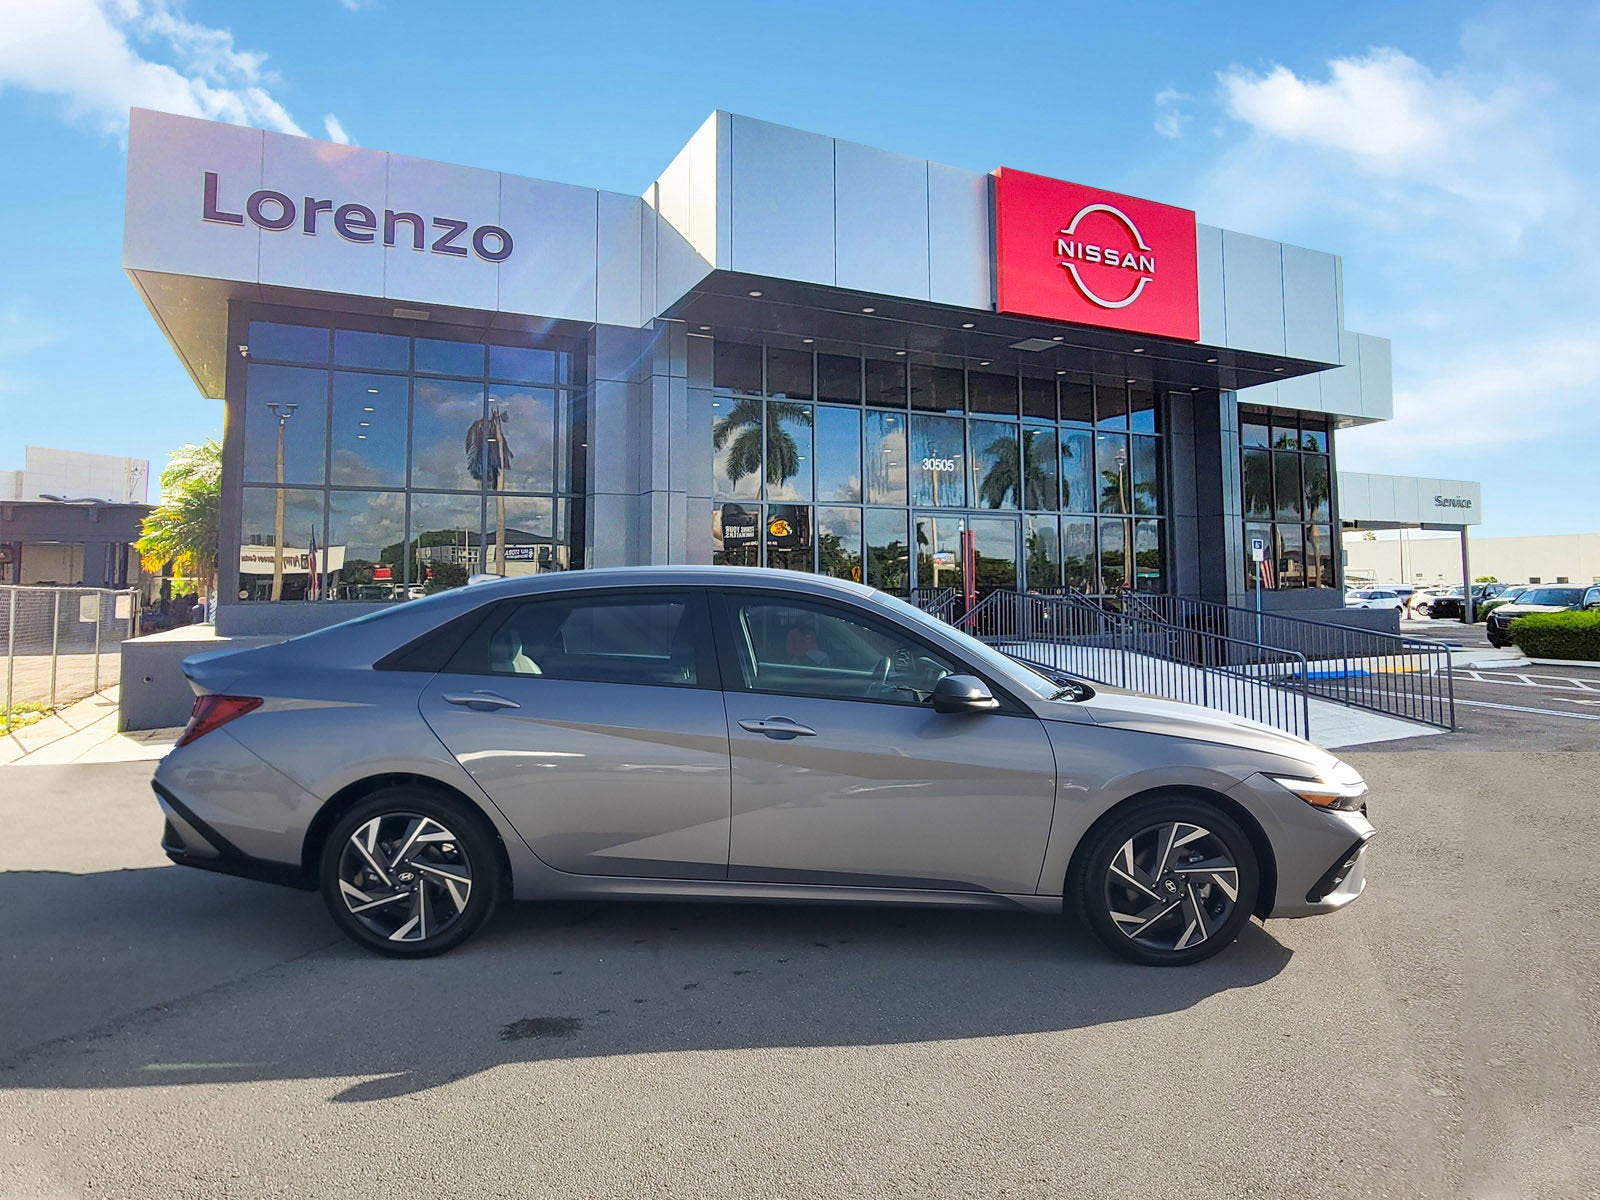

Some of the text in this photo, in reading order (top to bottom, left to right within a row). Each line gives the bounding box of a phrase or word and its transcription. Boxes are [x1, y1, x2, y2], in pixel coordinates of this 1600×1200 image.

[202, 171, 515, 262] Lorenzo
[1057, 238, 1155, 273] NISSAN
[922, 457, 954, 471] 30505
[1434, 495, 1472, 508] Service
